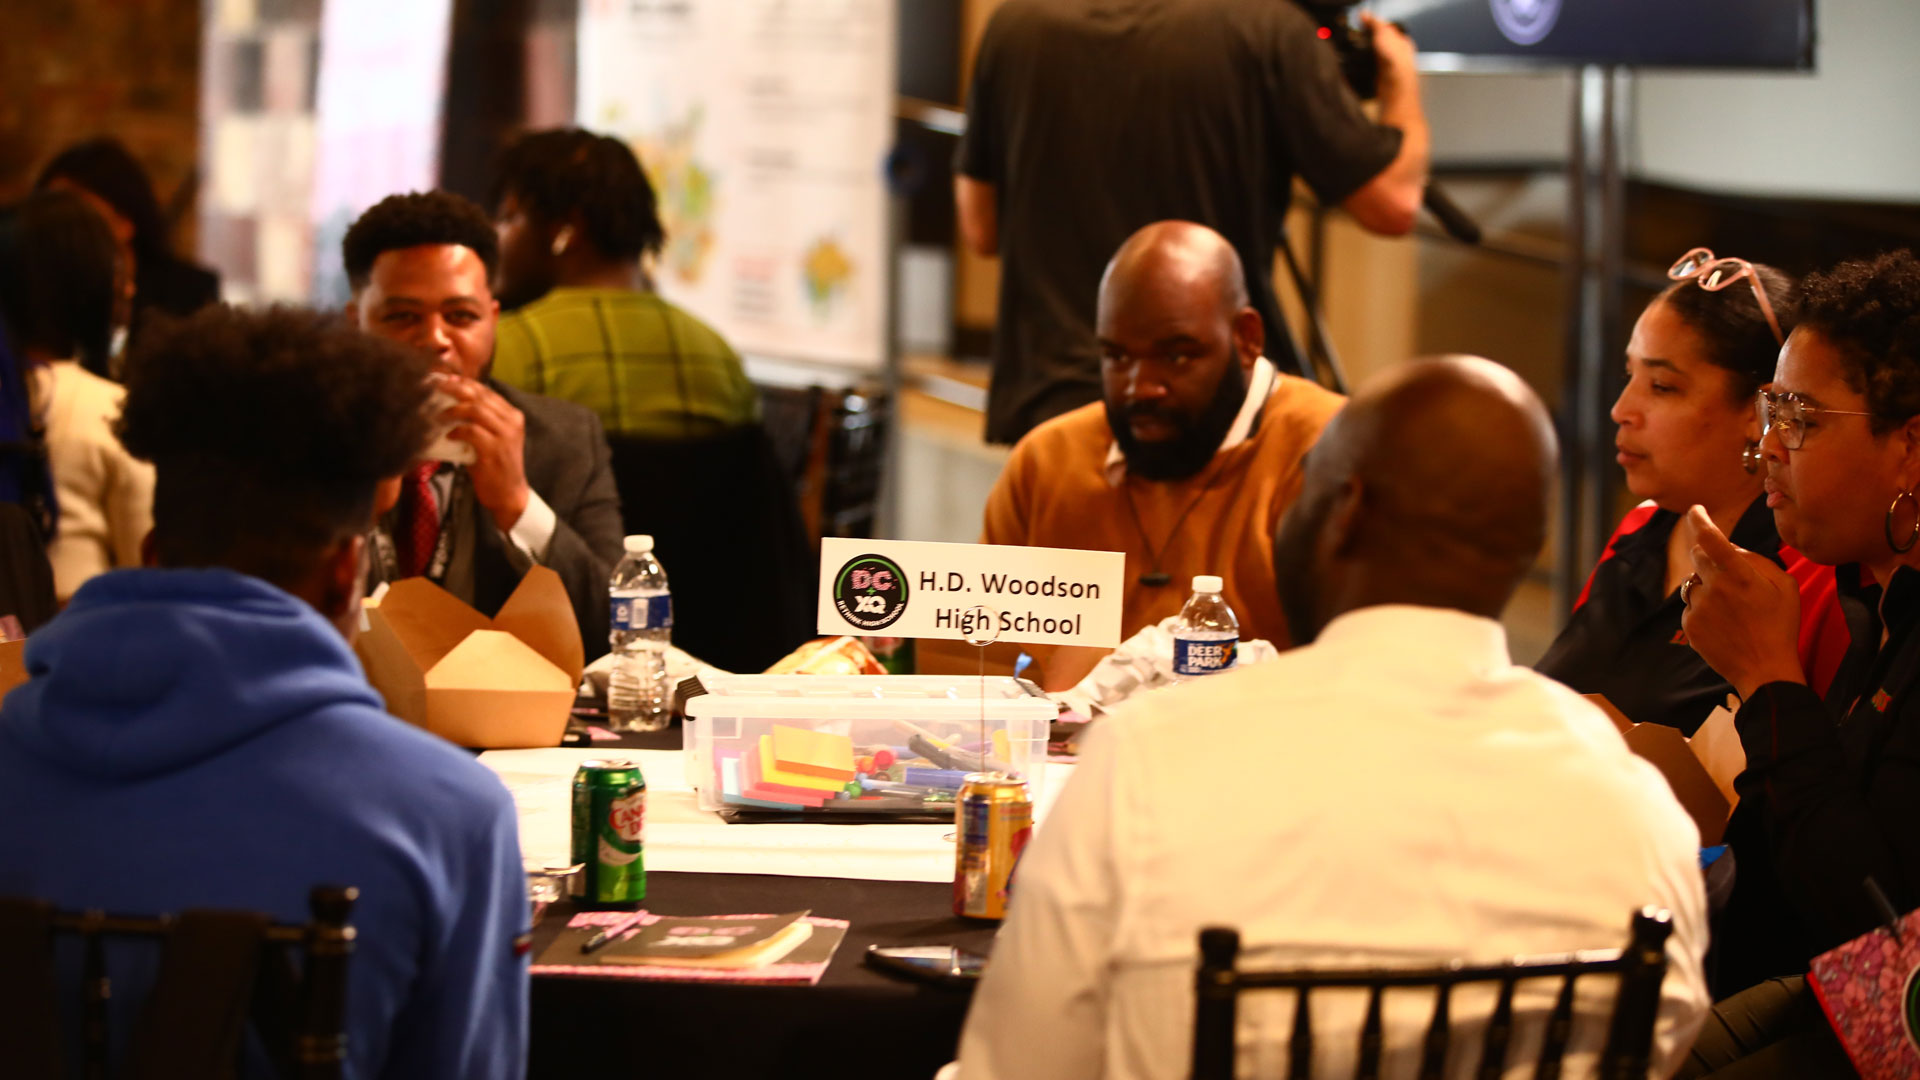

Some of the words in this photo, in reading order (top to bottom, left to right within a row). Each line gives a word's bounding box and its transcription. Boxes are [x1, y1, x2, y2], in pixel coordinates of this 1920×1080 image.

[851, 568, 893, 591] DC
[920, 571, 971, 592] H.D.
[981, 573, 1100, 599] Woodson
[854, 595, 887, 614] XQ
[936, 608, 990, 635] High
[1000, 611, 1081, 635] School
[1188, 645, 1222, 656] DEER
[1188, 656, 1222, 668] PARK
[609, 805, 645, 829] CAN
